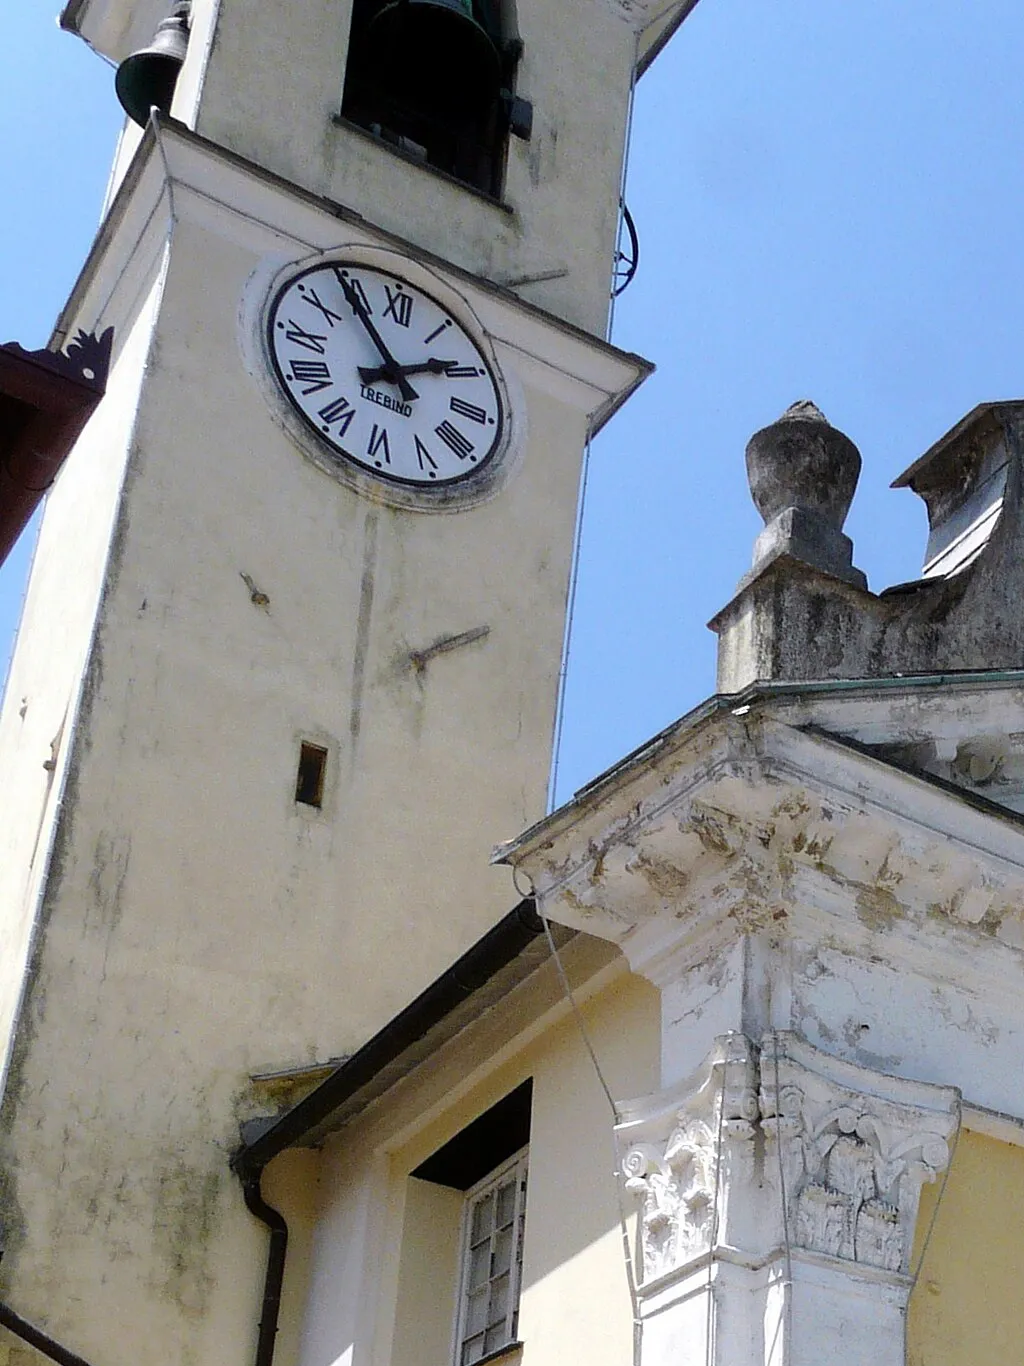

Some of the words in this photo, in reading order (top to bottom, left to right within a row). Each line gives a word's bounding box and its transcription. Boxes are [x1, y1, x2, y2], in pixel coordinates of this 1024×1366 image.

[301, 288, 343, 328] X
[382, 285, 414, 328] XII
[285, 319, 328, 355] IX
[424, 323, 447, 344] I
[289, 359, 334, 396] VIII
[444, 366, 480, 378] II
[317, 396, 357, 438] VII
[360, 384, 413, 418] TREBINO
[450, 396, 487, 425] III
[367, 424, 391, 465] VI
[414, 434, 439, 470] V
[434, 419, 476, 460] IIII
